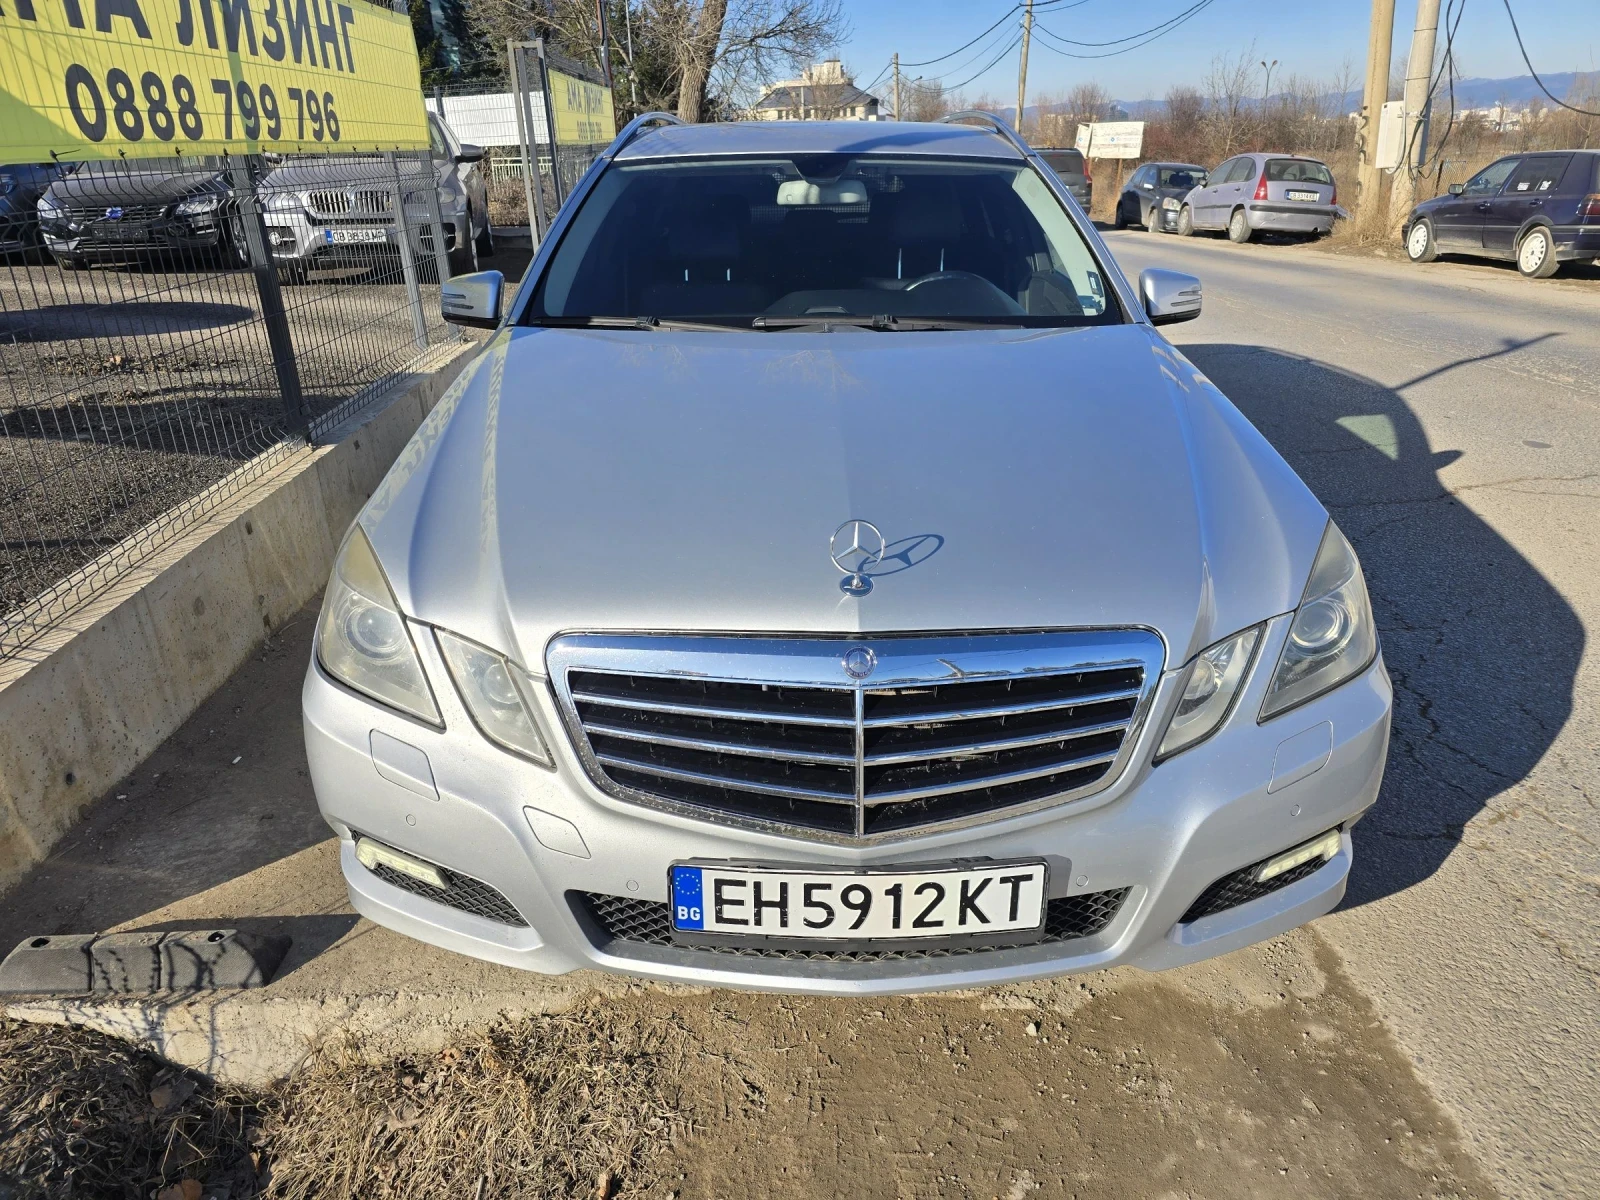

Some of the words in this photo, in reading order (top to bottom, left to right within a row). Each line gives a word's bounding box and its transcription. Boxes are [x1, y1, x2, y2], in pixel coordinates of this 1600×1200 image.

[176, 0, 356, 74] ЛИЗИНГ
[65, 63, 204, 143] 0888
[211, 79, 282, 142] 799
[287, 87, 342, 143] 796
[677, 907, 701, 921] BG
